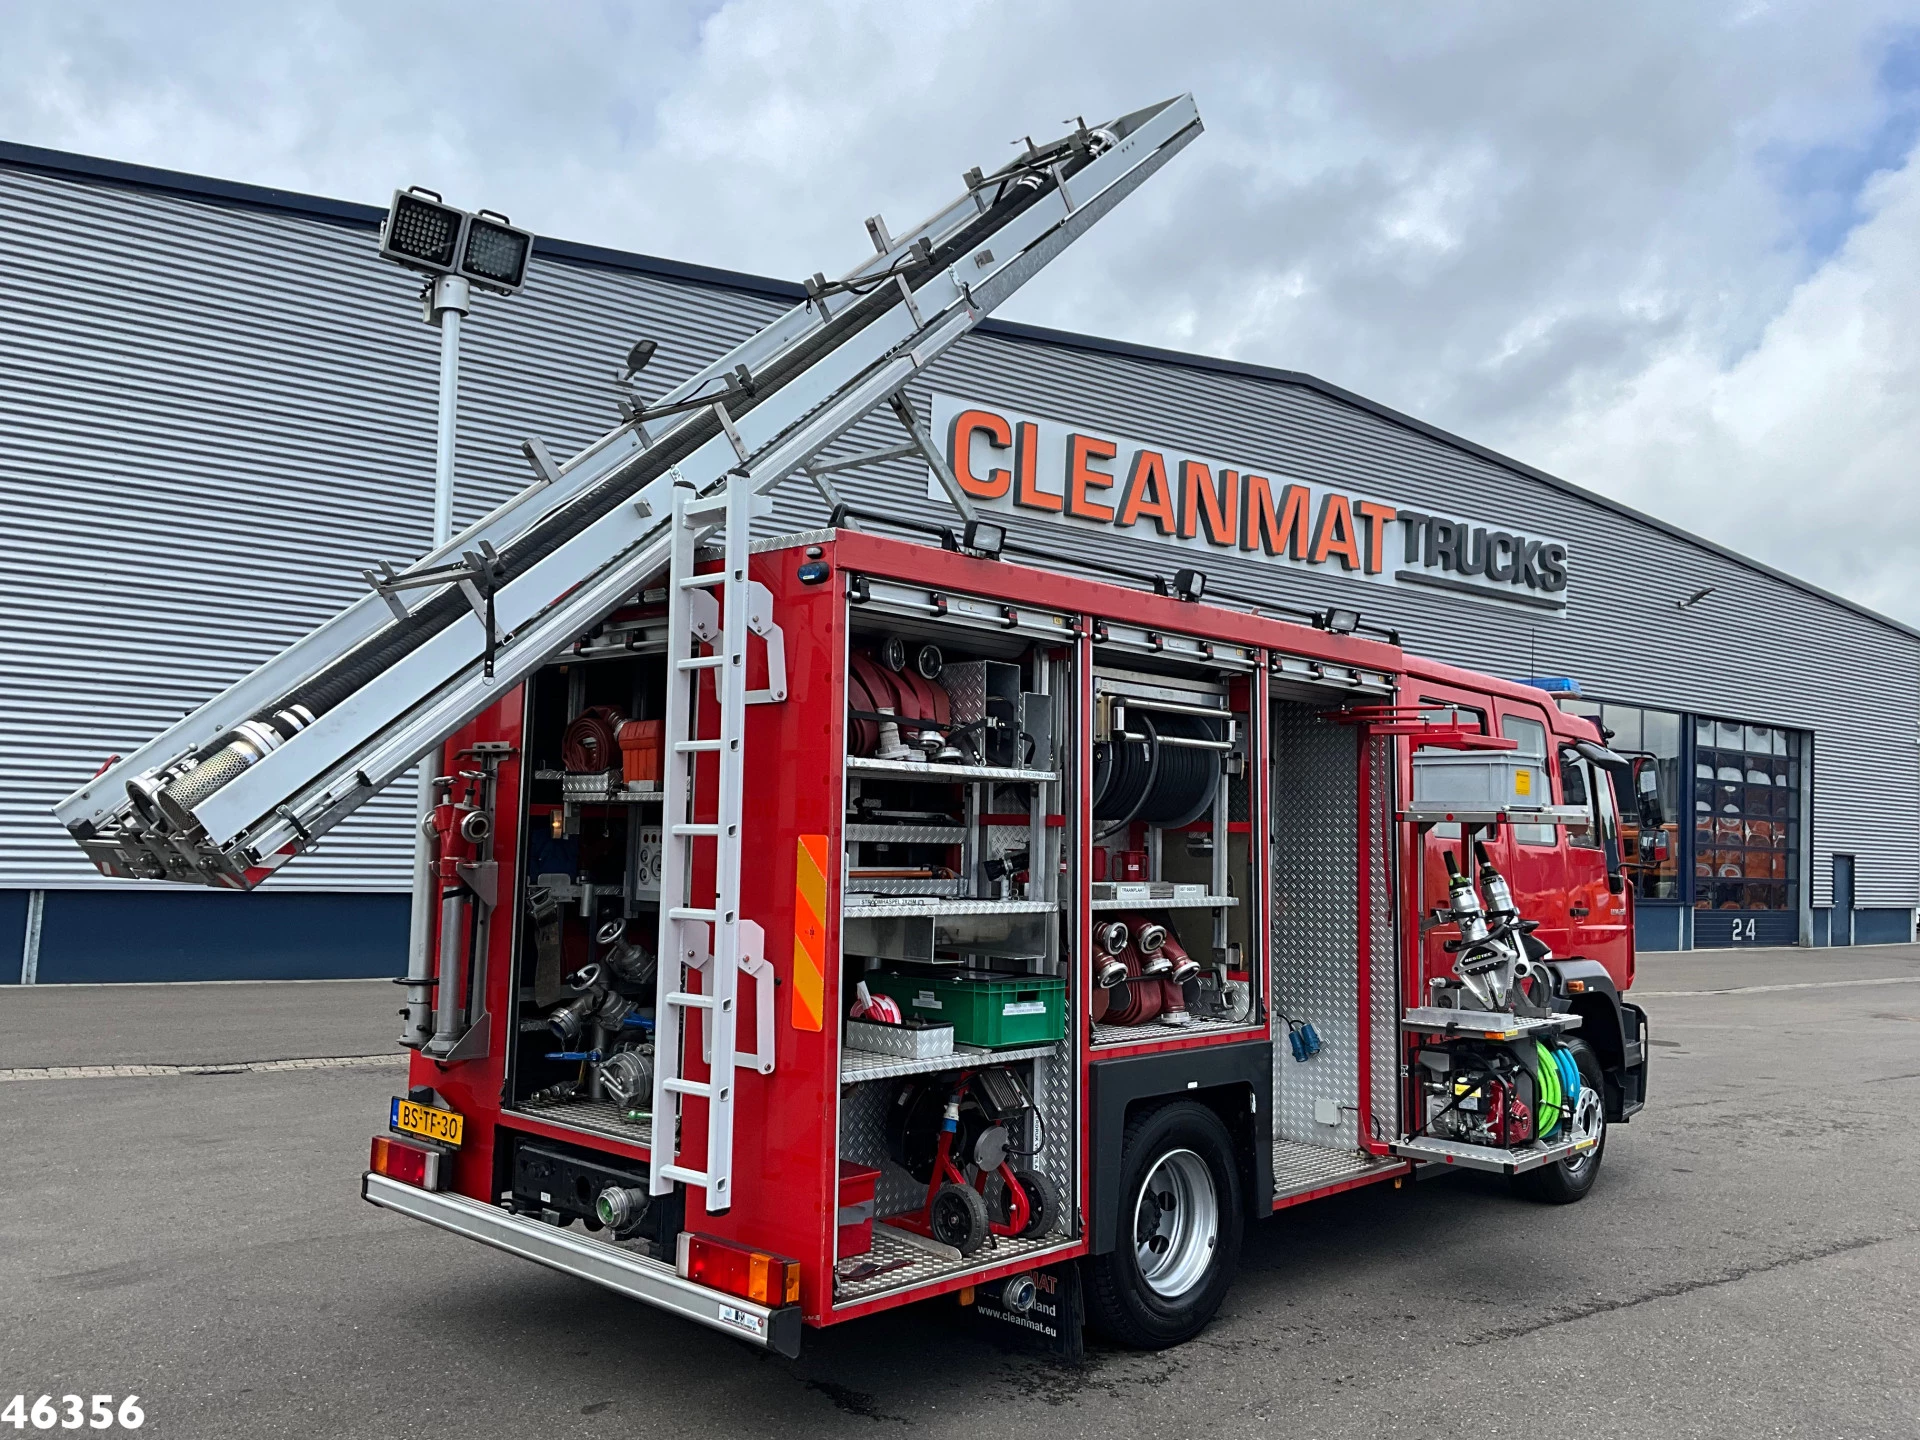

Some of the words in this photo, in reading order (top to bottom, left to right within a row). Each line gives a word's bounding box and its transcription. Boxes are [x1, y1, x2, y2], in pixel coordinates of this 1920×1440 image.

[946, 409, 1397, 575] CLEANMAT
[1396, 510, 1568, 593] TRUCKS
[1732, 918, 1756, 941] 24
[403, 1105, 458, 1139] BS-TF-30
[977, 1305, 1057, 1338] www.cleanmat.eu
